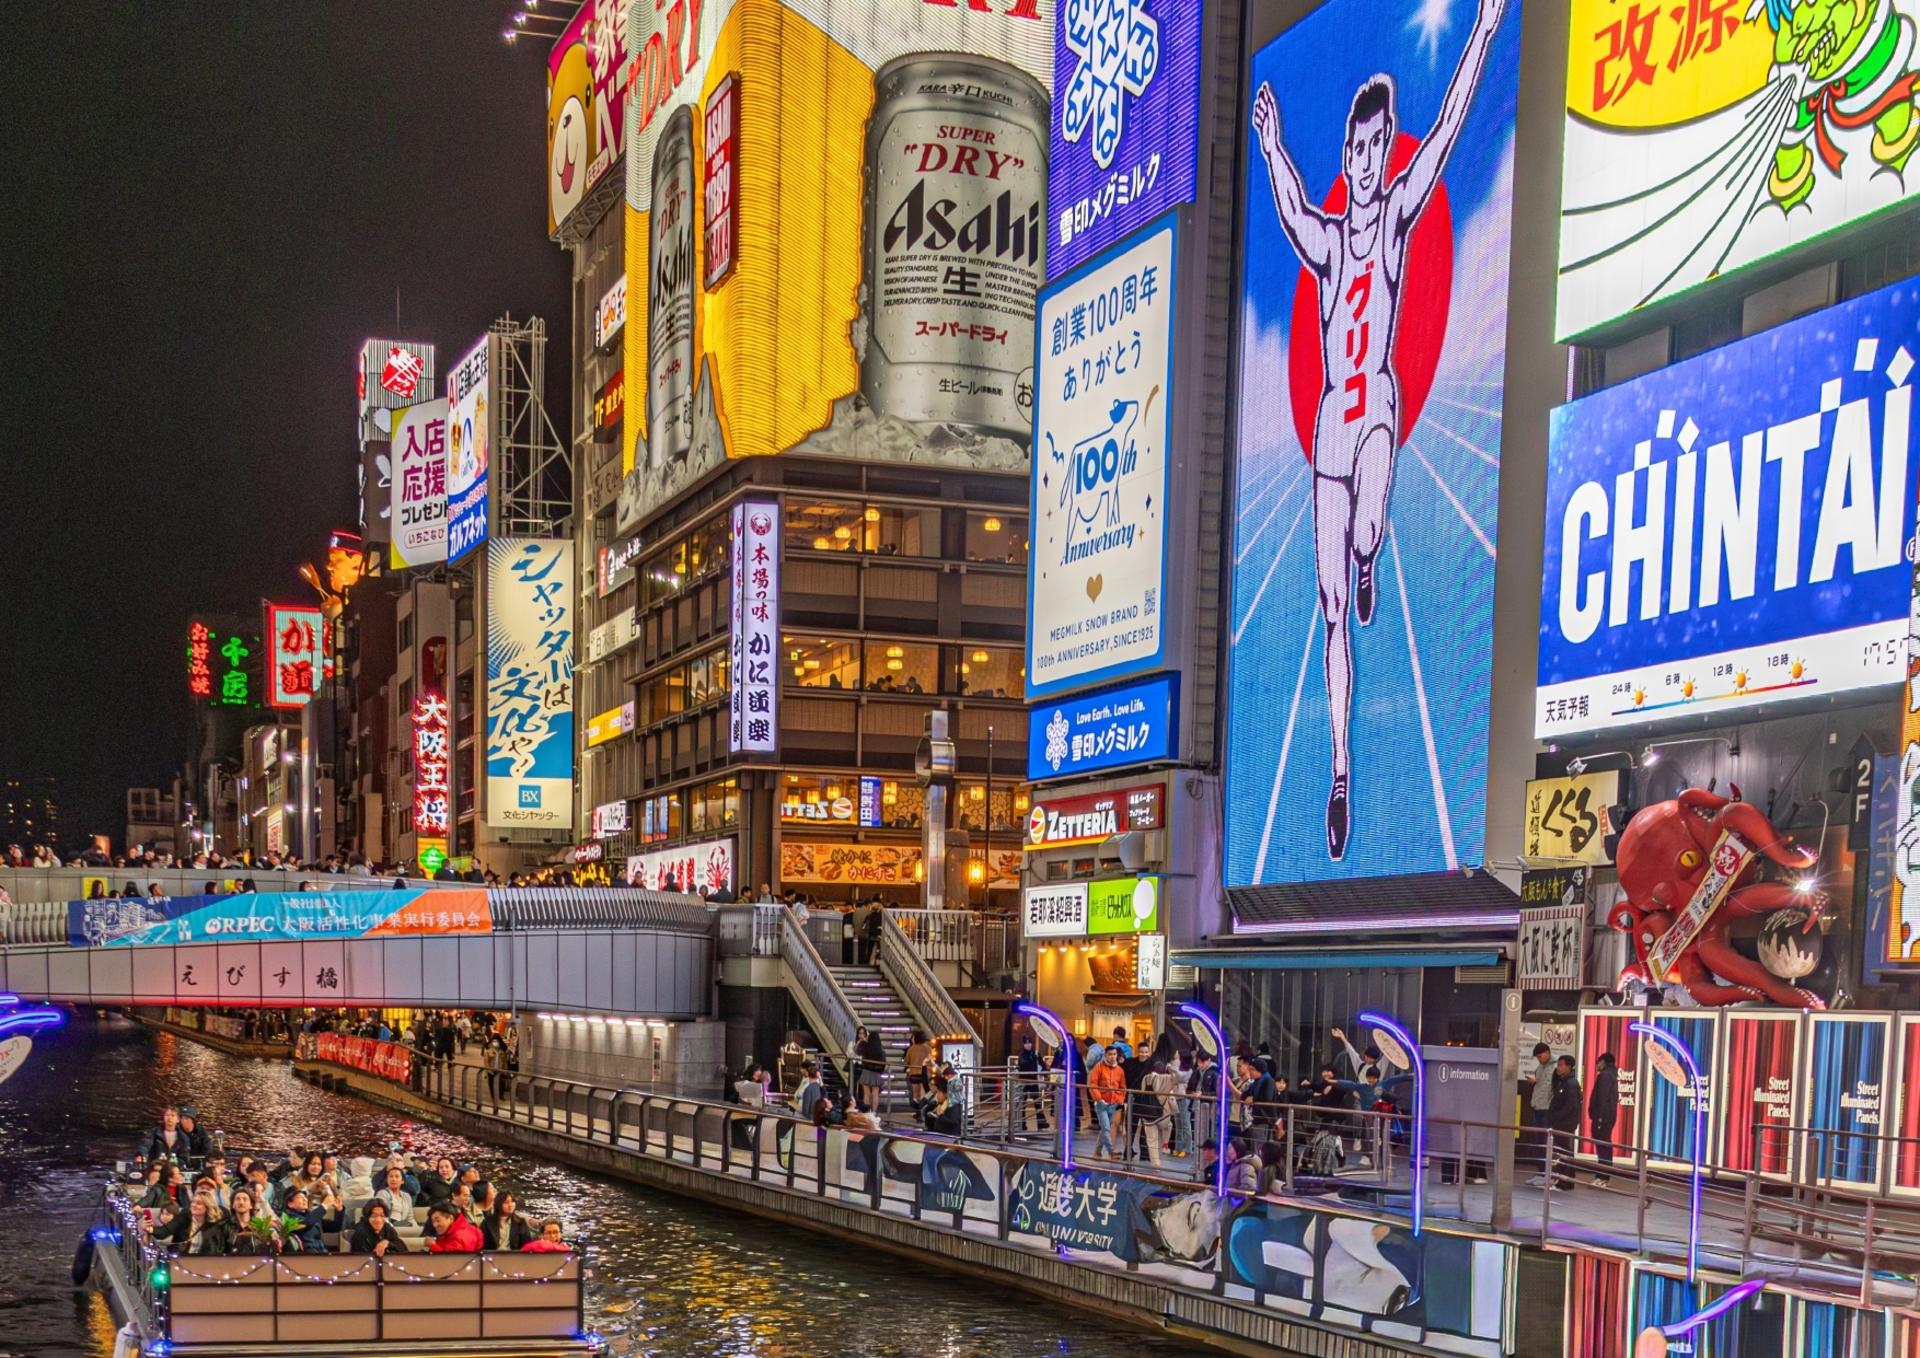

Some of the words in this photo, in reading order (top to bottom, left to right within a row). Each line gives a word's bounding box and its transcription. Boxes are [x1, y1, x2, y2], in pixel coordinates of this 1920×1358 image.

[918, 84, 947, 93] KARA
[982, 90, 1013, 105] KUCHI
[937, 125, 996, 145] SUPER
[904, 143, 1024, 180] “DRY”
[706, 162, 731, 226] 1889
[1060, 152, 1161, 247] 雪印メグミルク
[883, 180, 1039, 267] Asahi
[705, 218, 729, 278] OSAKA
[919, 254, 931, 262] DRY
[939, 255, 967, 263] BREWED
[968, 257, 986, 265] WITH
[986, 261, 1017, 273] PRECISION
[943, 267, 981, 297] 生
[985, 271, 1007, 281] UNDER
[1009, 276, 1020, 284] THE
[985, 281, 1012, 293] MASTER
[941, 297, 962, 306] TASTE
[962, 300, 978, 308] AND
[1001, 307, 1020, 317] CLEAN
[1052, 265, 1158, 357] 創業100周年
[915, 321, 1008, 345] スーパードライ
[1344, 260, 1375, 424] グリコ
[1063, 330, 1141, 402] ありがとう
[939, 379, 980, 395] 生ビール
[402, 419, 445, 463] 入店
[402, 458, 445, 503] 応援
[1559, 338, 1915, 645] CHINTAI
[1063, 522, 1136, 567] Anniversary
[752, 542, 770, 623] 本場の味
[1050, 623, 1082, 641] MEGMILK
[1086, 615, 1108, 632] SNOW
[1111, 605, 1138, 625] BRAND
[1037, 651, 1055, 669] 100th
[1713, 664, 1733, 677] 12時
[1767, 653, 1789, 667] 18時
[1612, 682, 1632, 695] 24時
[1665, 673, 1680, 686] 6時
[1077, 710, 1091, 725] Love
[1092, 707, 1112, 721] Earth.
[1114, 702, 1130, 717] Love
[1130, 699, 1145, 713] Life.
[1545, 695, 1590, 723] 天気予報
[1072, 721, 1149, 762] 雪印メグミルク
[415, 694, 449, 828] 大阪王将
[521, 791, 539, 802] BX
[1047, 810, 1117, 841] ZETTERIA
[1541, 786, 1598, 854] くくる
[283, 911, 481, 932] 大阪活性化事業実行委員会
[181, 964, 338, 989] えびす橋
[1449, 1067, 1489, 1081] information
[1769, 1076, 1790, 1091] Street
[1753, 1087, 1790, 1104] Illuminated
[1857, 1081, 1879, 1096] Street
[1767, 1103, 1791, 1118] Panels.
[1840, 1092, 1880, 1110] Illuminated
[1856, 1108, 1880, 1124] Panels.
